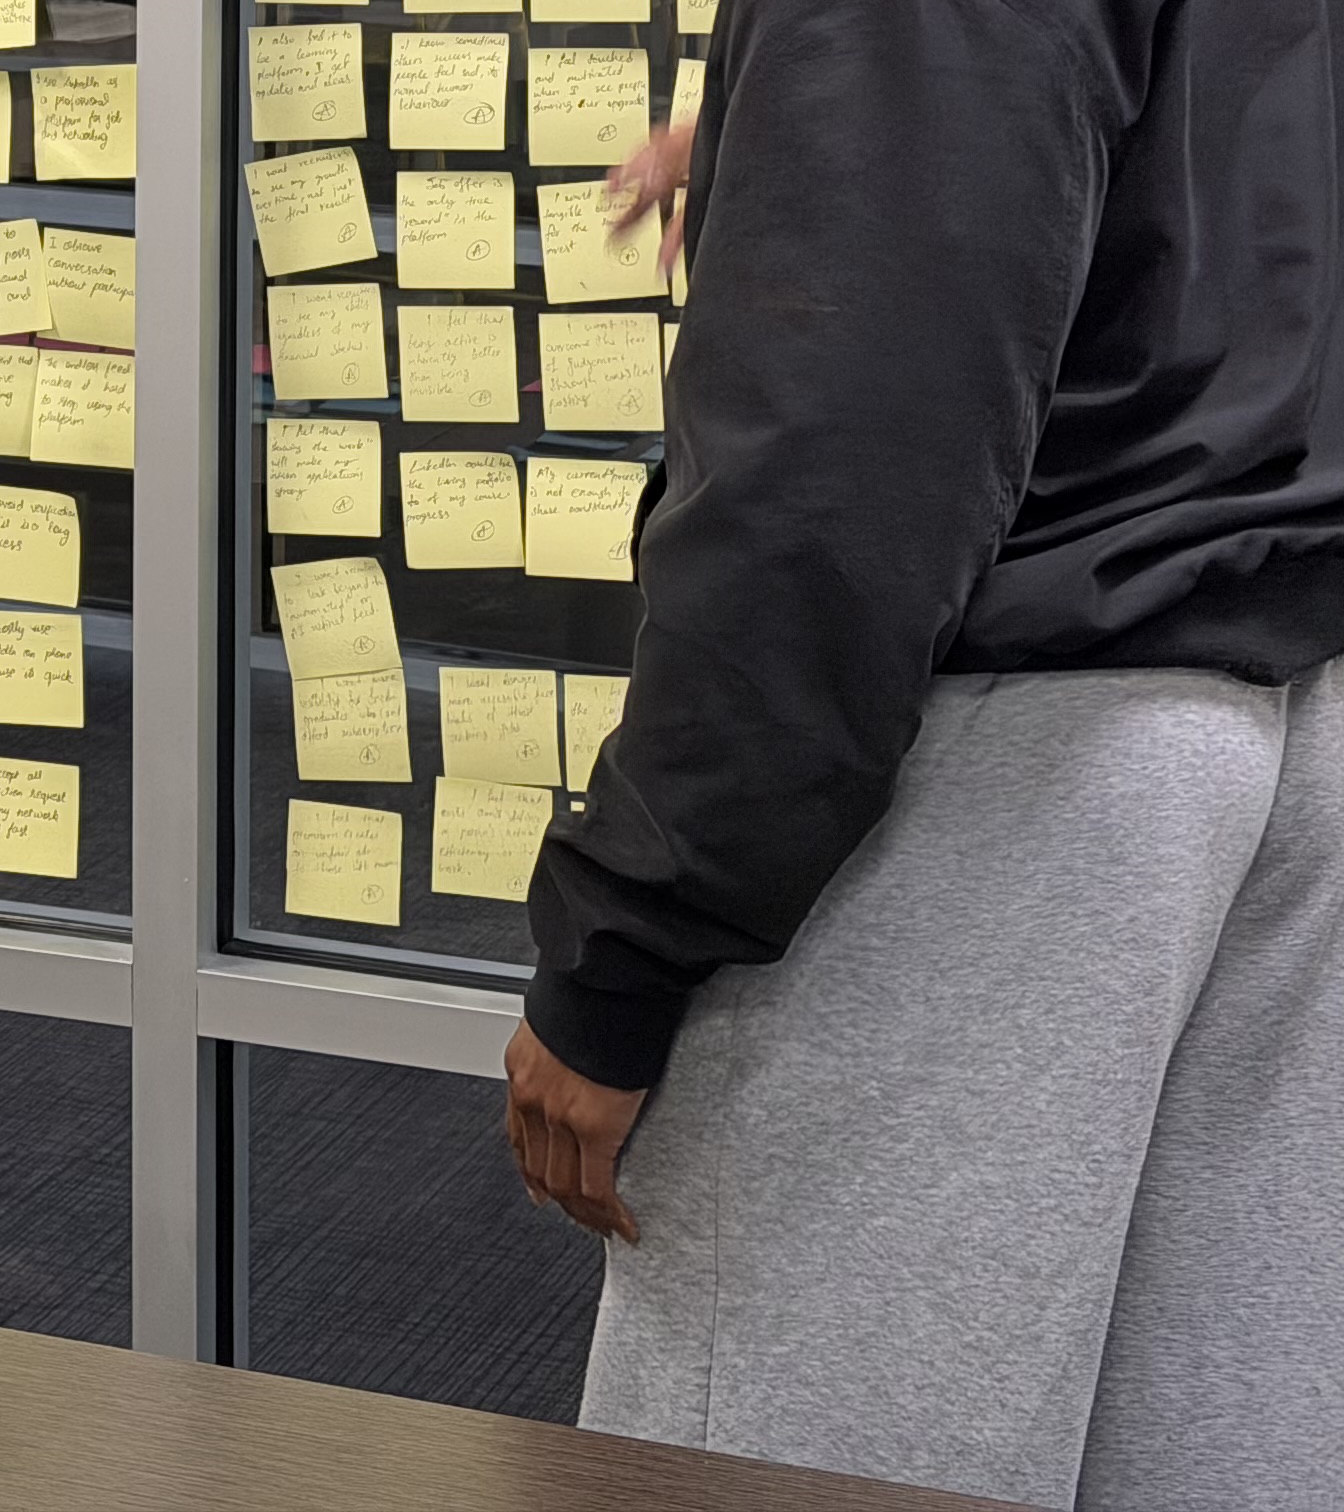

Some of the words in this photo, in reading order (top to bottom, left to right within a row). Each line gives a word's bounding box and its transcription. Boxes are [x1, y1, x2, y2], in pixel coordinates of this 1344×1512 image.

[425, 178, 447, 190] Job
[454, 175, 485, 190] offer
[401, 196, 417, 208] the
[426, 196, 454, 211] only
[474, 211, 499, 223] the
[402, 229, 447, 247] platform
[17, 806, 59, 822] network
